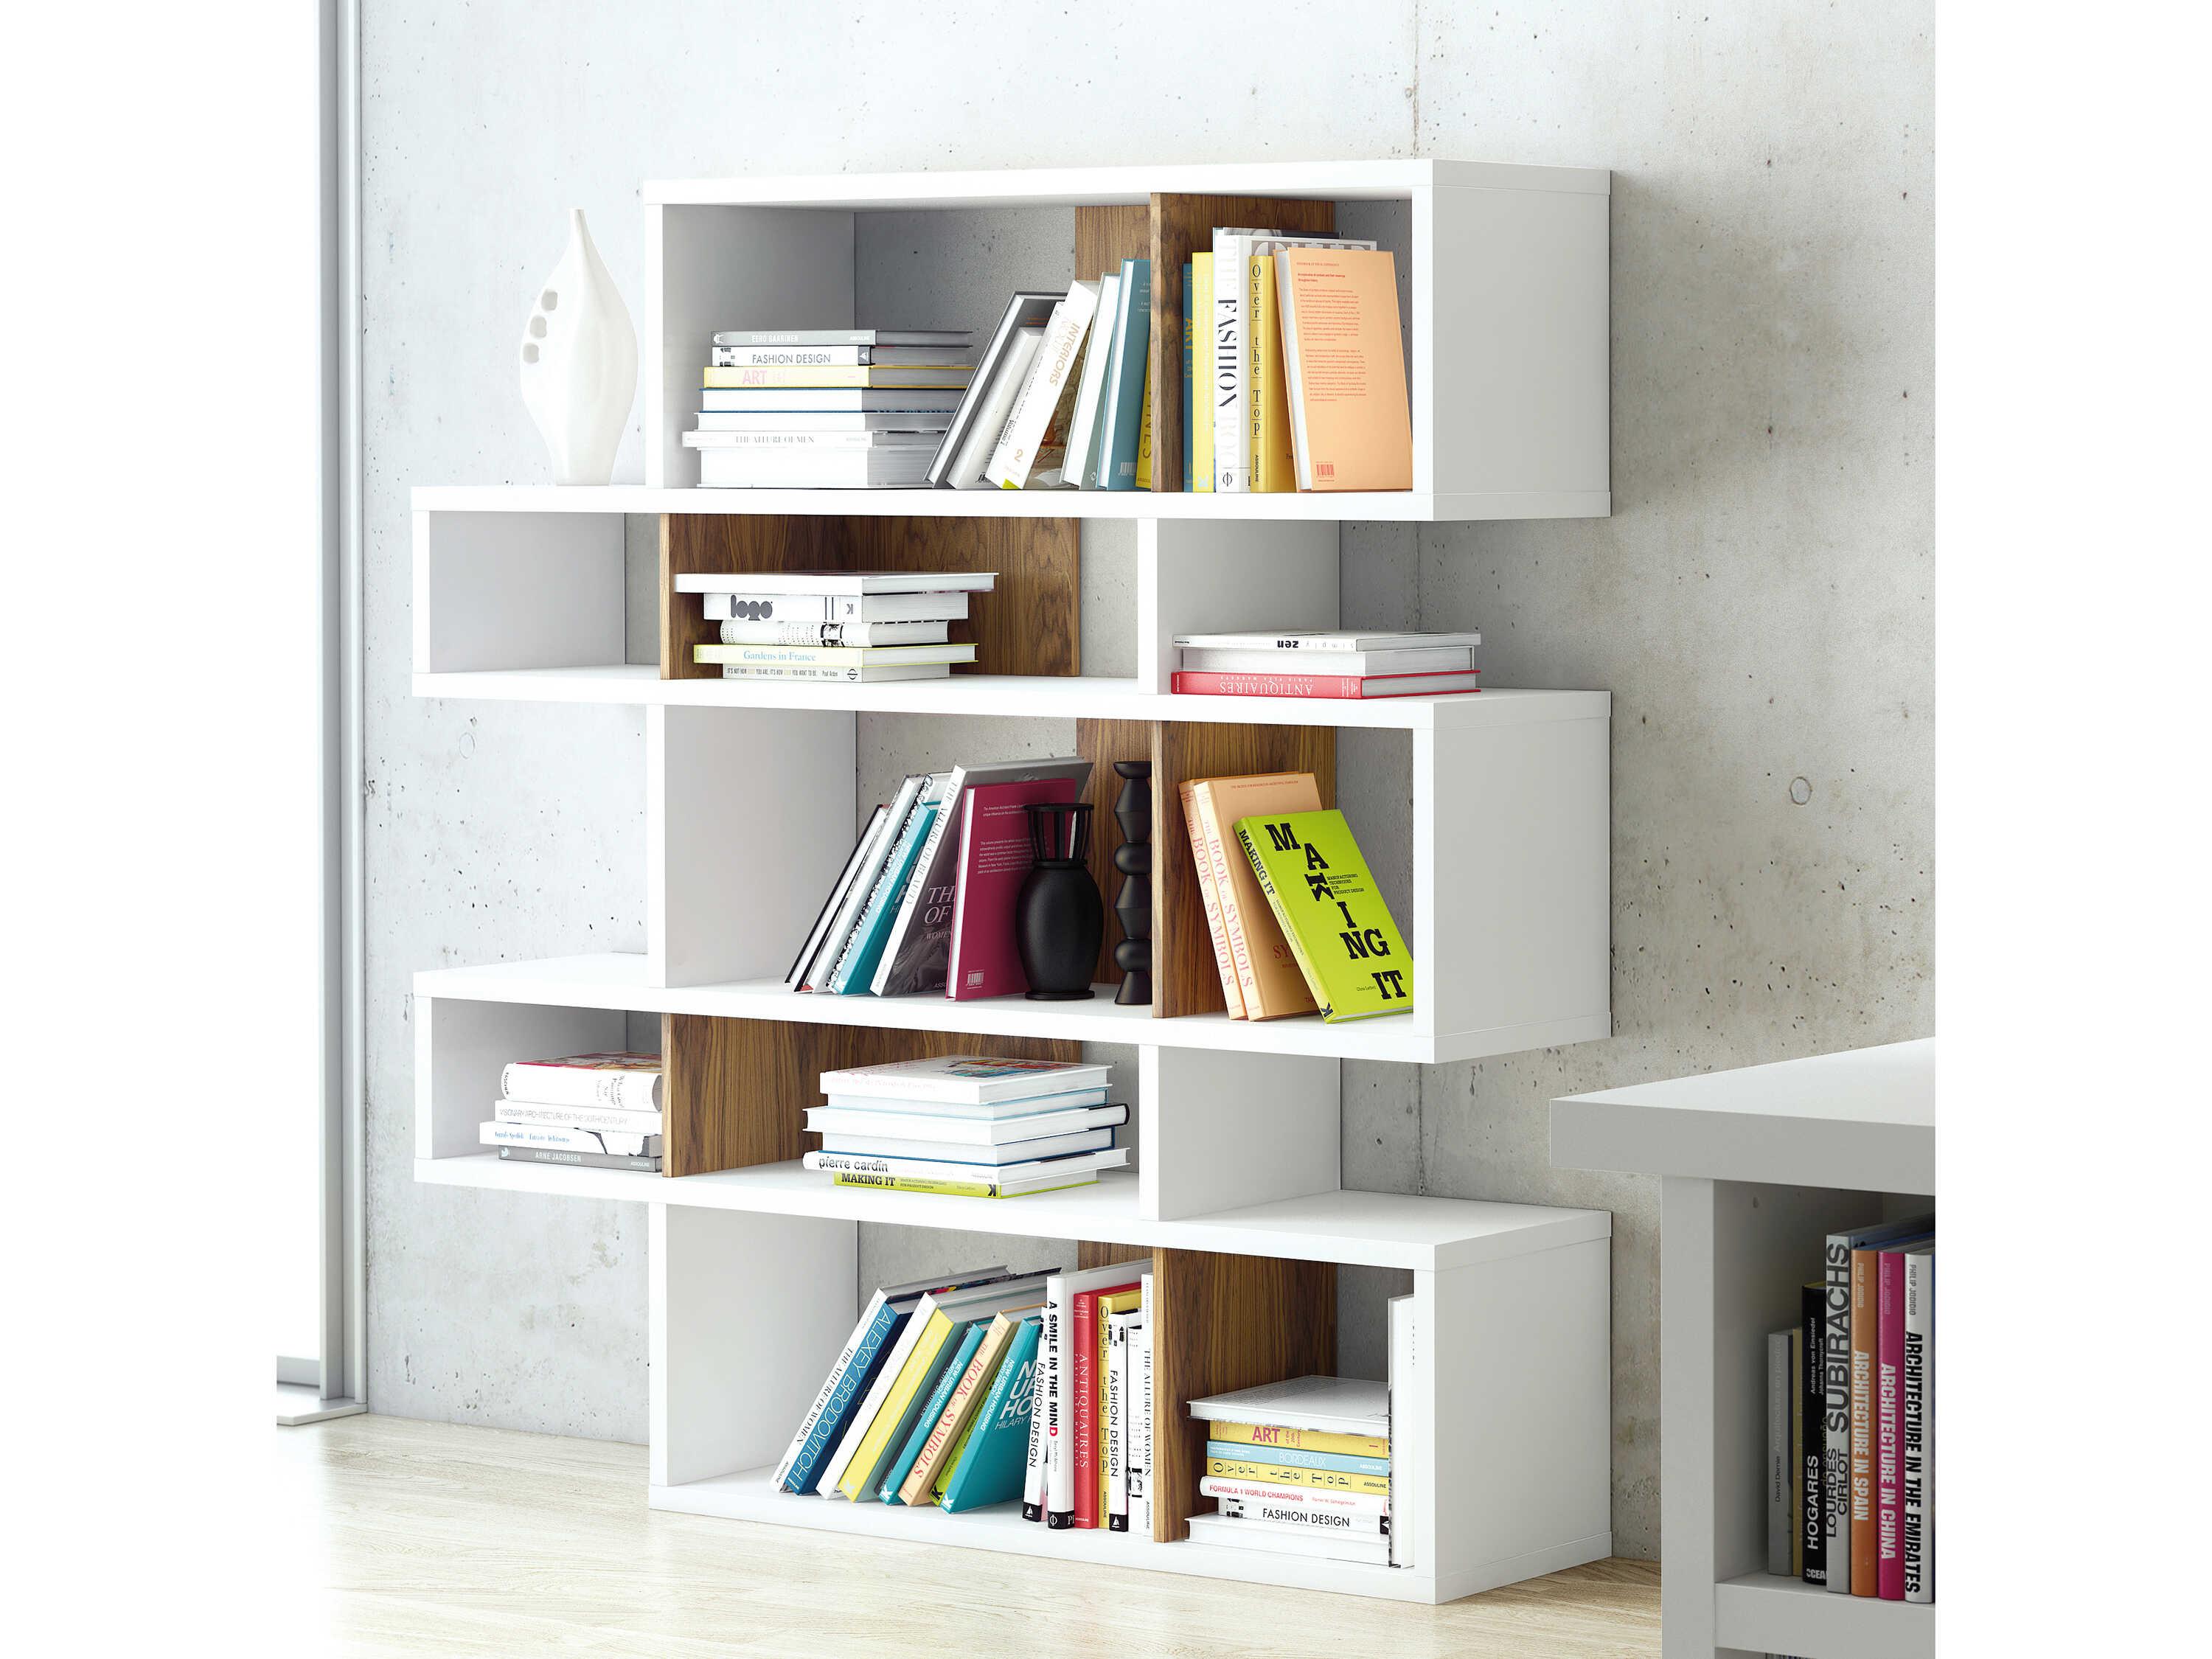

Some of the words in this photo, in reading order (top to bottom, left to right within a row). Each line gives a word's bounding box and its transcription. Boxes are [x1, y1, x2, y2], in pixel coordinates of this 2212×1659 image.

[1252, 264, 1262, 318] Over
[752, 354, 793, 364] FASHION
[796, 353, 831, 364] DESIGN
[1049, 322, 1079, 386] INTERIORS
[1218, 299, 1237, 406] FASHION
[1253, 335, 1261, 375] the
[742, 370, 768, 385] ART
[1253, 390, 1262, 437] Top
[1014, 448, 1023, 463] 2
[730, 594, 773, 621] logo
[743, 650, 776, 661] Gardens
[779, 652, 787, 660] in
[789, 652, 816, 661] France
[1277, 640, 1298, 649] zen
[1220, 681, 1312, 696] ANTIQUAIRES
[1238, 829, 1267, 880] MAKING
[1263, 879, 1276, 896] IT
[928, 886, 956, 905] TH
[924, 905, 951, 925] OF
[1192, 837, 1213, 886] BOOK
[1206, 902, 1234, 987] SYMBOLS
[1209, 838, 1230, 888] BOOK
[1225, 903, 1253, 988] SYMBOLS
[1371, 970, 1407, 1000] IT
[1320, 1002, 1334, 1018] K
[572, 1113, 583, 1121] THE
[535, 1151, 551, 1160] ARNE
[552, 1152, 582, 1162] JACOBSEN
[818, 1155, 850, 1169] pierre
[854, 1159, 888, 1172] cardin
[841, 1173, 883, 1186] MAKING
[884, 1177, 896, 1186] IT
[1049, 1301, 1058, 1310] A
[1908, 1288, 1916, 1315] JODIDIO
[848, 1308, 894, 1378] ALEXEY
[1049, 1315, 1059, 1353] SMILE
[1101, 1305, 1109, 1358] Over
[1826, 1242, 1849, 1433] SUBIRACHS
[841, 1347, 853, 1363] THE
[977, 1343, 989, 1357] THE
[1049, 1357, 1058, 1370] IN
[820, 1362, 844, 1400] ALLURE
[950, 1360, 963, 1377] NEW
[956, 1358, 984, 1399] BOOK
[1003, 1359, 1016, 1376] NEW
[938, 1375, 955, 1399] URBAN
[992, 1375, 1009, 1399] URBAN
[1034, 1363, 1046, 1418] FASHION
[1049, 1374, 1058, 1398] THE
[1110, 1370, 1119, 1426] FASHION
[1905, 1331, 1923, 1453] ARCHITECTURE
[814, 1397, 827, 1411] OF
[922, 1398, 942, 1428] HOUSING
[949, 1397, 958, 1408] OF
[977, 1399, 998, 1430] HOUSING
[1079, 1353, 1089, 1469] ANTIQUAIRES
[1854, 1350, 1870, 1455] ARCHITECTURE
[790, 1373, 858, 1482] BRODOVITCH
[795, 1408, 819, 1446] WOMEN
[995, 1416, 1028, 1430] HILARY
[1049, 1402, 1059, 1437] MIND
[1144, 1417, 1151, 1431] OF
[1252, 1426, 1281, 1443] ART
[1773, 1391, 1783, 1453] Arquitectura
[1881, 1363, 1896, 1484] ARCHITECTURE
[912, 1408, 956, 1478] SYMBOLS
[1029, 1419, 1040, 1468] DESIGN
[1101, 1428, 1109, 1473] Top
[1110, 1428, 1119, 1477] DESIGN
[1213, 1462, 1256, 1474] Over
[1270, 1471, 1301, 1481] the
[1312, 1473, 1349, 1486] Top
[1279, 1453, 1326, 1467] BORDEAUX
[1854, 1458, 1869, 1474] IN
[1905, 1456, 1921, 1473] IN
[929, 1486, 944, 1501] K
[1209, 1485, 1239, 1495] FORMULA
[1244, 1489, 1267, 1498] WORLD
[1267, 1491, 1304, 1502] CHAMPIONS
[1826, 1448, 1837, 1538] LOURDES
[1837, 1451, 1848, 1516] CIRLOT
[1881, 1487, 1896, 1505] IN
[1905, 1478, 1921, 1508] THE
[1806, 1455, 1819, 1551] HOGARES
[1854, 1477, 1869, 1521] SPAIN
[1263, 1508, 1307, 1523] FASHION
[1312, 1514, 1350, 1527] DESIGN
[1881, 1509, 1896, 1559] CHINA
[1905, 1512, 1921, 1593] EMIRATES
